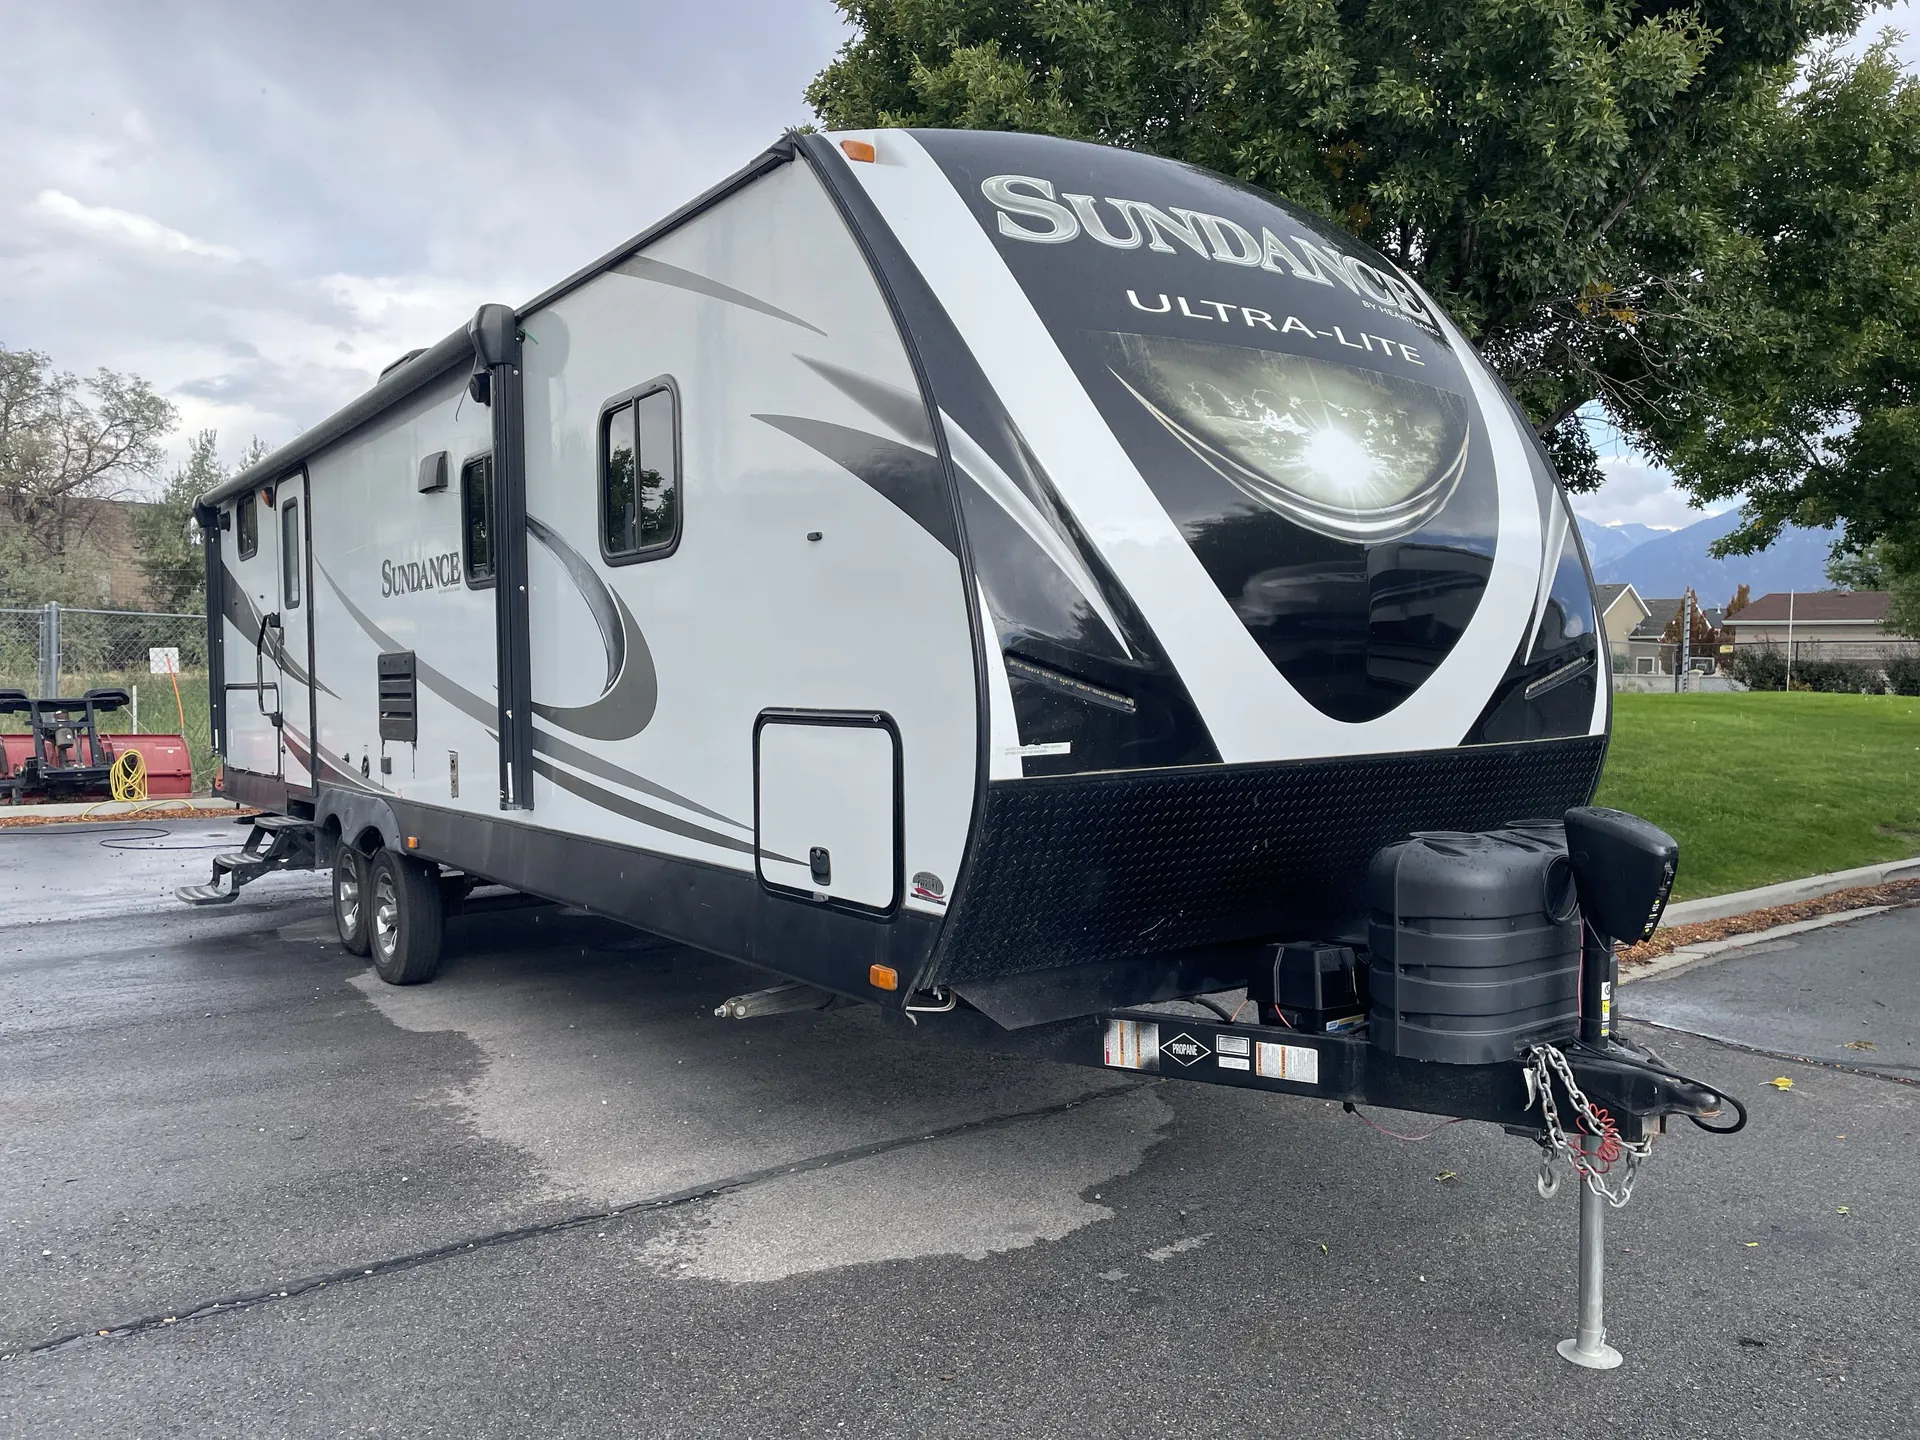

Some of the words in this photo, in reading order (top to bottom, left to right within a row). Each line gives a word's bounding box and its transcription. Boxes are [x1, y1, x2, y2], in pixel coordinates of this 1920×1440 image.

[981, 174, 1435, 325] SUNDANCE
[1126, 289, 1426, 367] ULTRA-LITE
[1361, 299, 1377, 310] BY
[1378, 305, 1440, 337] HEARTLAND
[381, 551, 461, 599] SUNDANCE
[1172, 1042, 1198, 1056] PROPANE
